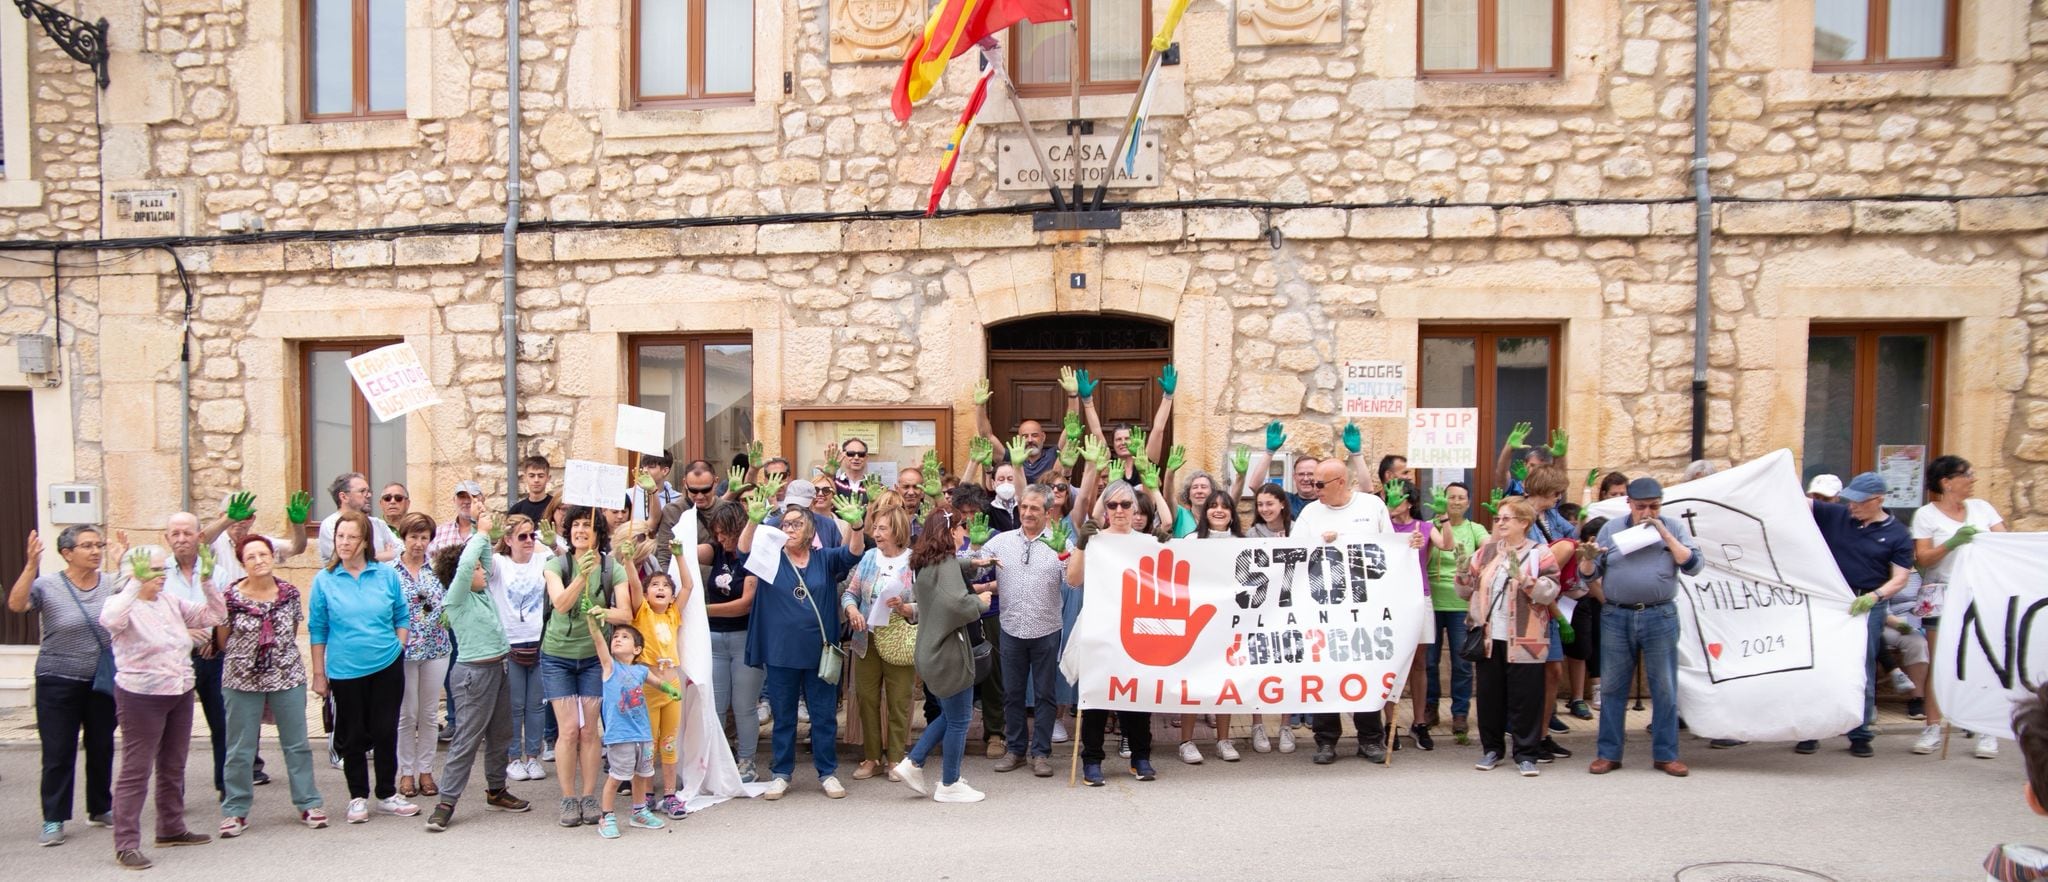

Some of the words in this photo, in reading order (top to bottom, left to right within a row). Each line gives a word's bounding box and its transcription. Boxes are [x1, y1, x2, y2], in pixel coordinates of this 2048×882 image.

[1048, 144, 1107, 162] CASA
[140, 199, 163, 208] PLAZA
[1074, 275, 1081, 287] 1
[1348, 365, 1403, 378] BIOGAS
[1347, 382, 1402, 396] BONITA
[1347, 399, 1403, 413] AMENAZA
[1415, 413, 1472, 428] STOP
[1426, 432, 1436, 445] A
[1446, 432, 1465, 445] LA
[1412, 448, 1473, 463] PLANTA
[1234, 543, 1387, 609] STOP
[1231, 607, 1392, 628] PLANTA
[1740, 634, 1785, 658] 2024
[1109, 672, 1397, 706] MILAGROS
